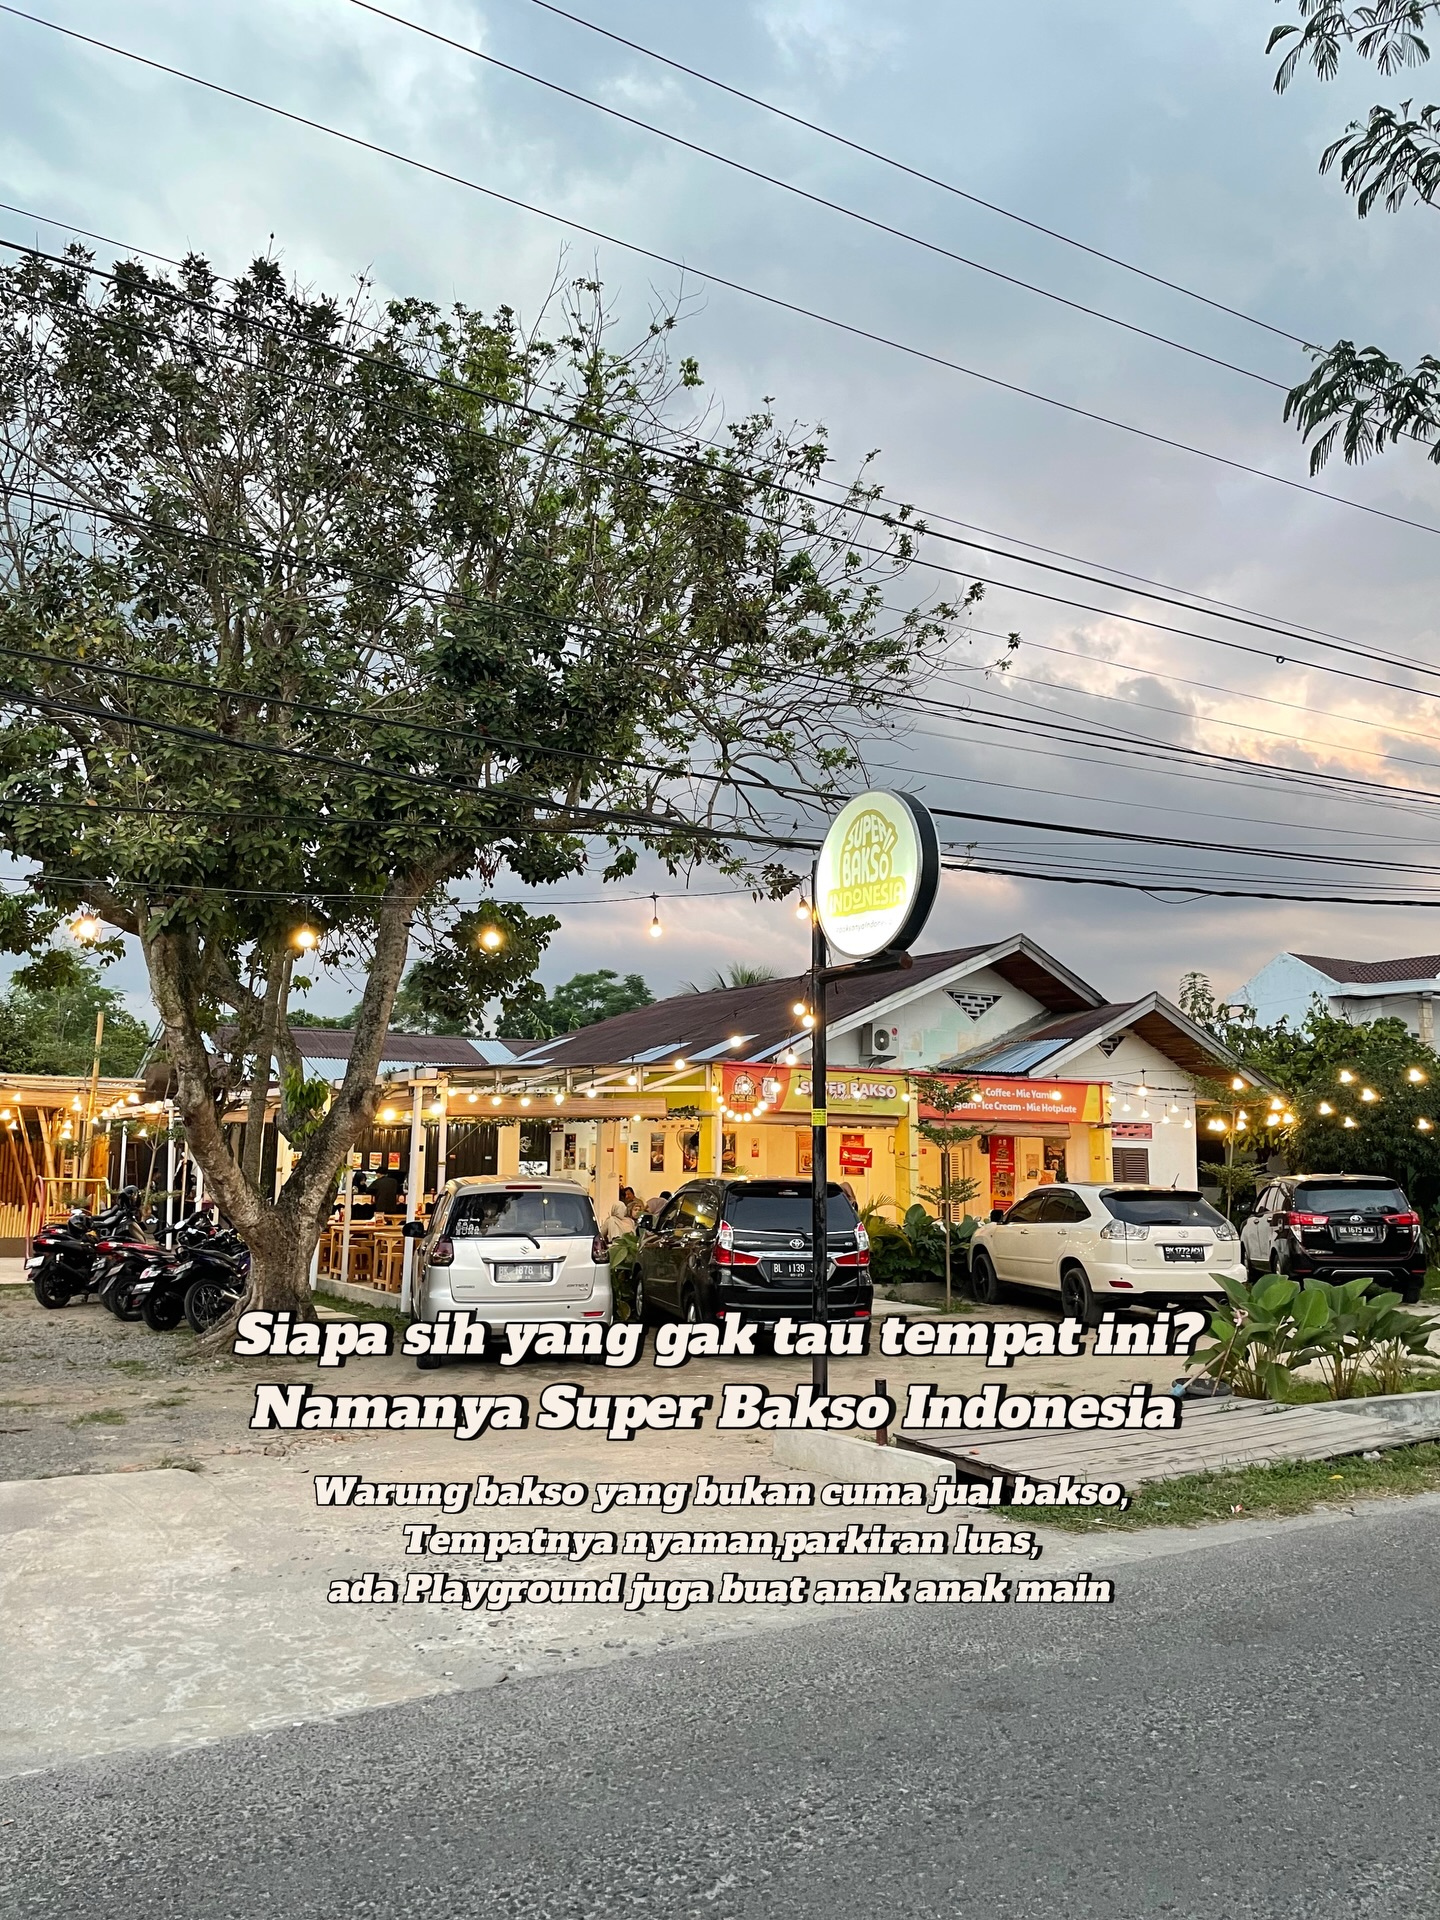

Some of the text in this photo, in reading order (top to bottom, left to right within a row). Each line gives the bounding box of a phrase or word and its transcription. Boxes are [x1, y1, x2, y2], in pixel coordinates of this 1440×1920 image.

[845, 814, 892, 851] SUPER
[843, 846, 889, 886] BAKSO
[829, 882, 905, 913] INDONESIA
[800, 1081, 897, 1098] SER BAKSO
[985, 1087, 1012, 1098] Coffee
[1016, 1089, 1031, 1099] Mie
[1031, 1089, 1061, 1100] Yami
[982, 1101, 995, 1111] Ice
[995, 1102, 1022, 1112] Cream
[1026, 1103, 1041, 1112] Mie
[1041, 1104, 1077, 1115] Hotplate
[1165, 1246, 1175, 1255] BK
[1174, 1246, 1191, 1255] 1772
[498, 1265, 509, 1275] BK
[515, 1265, 534, 1275] 1878
[773, 1263, 783, 1273] BL
[788, 1263, 806, 1273] 1139
